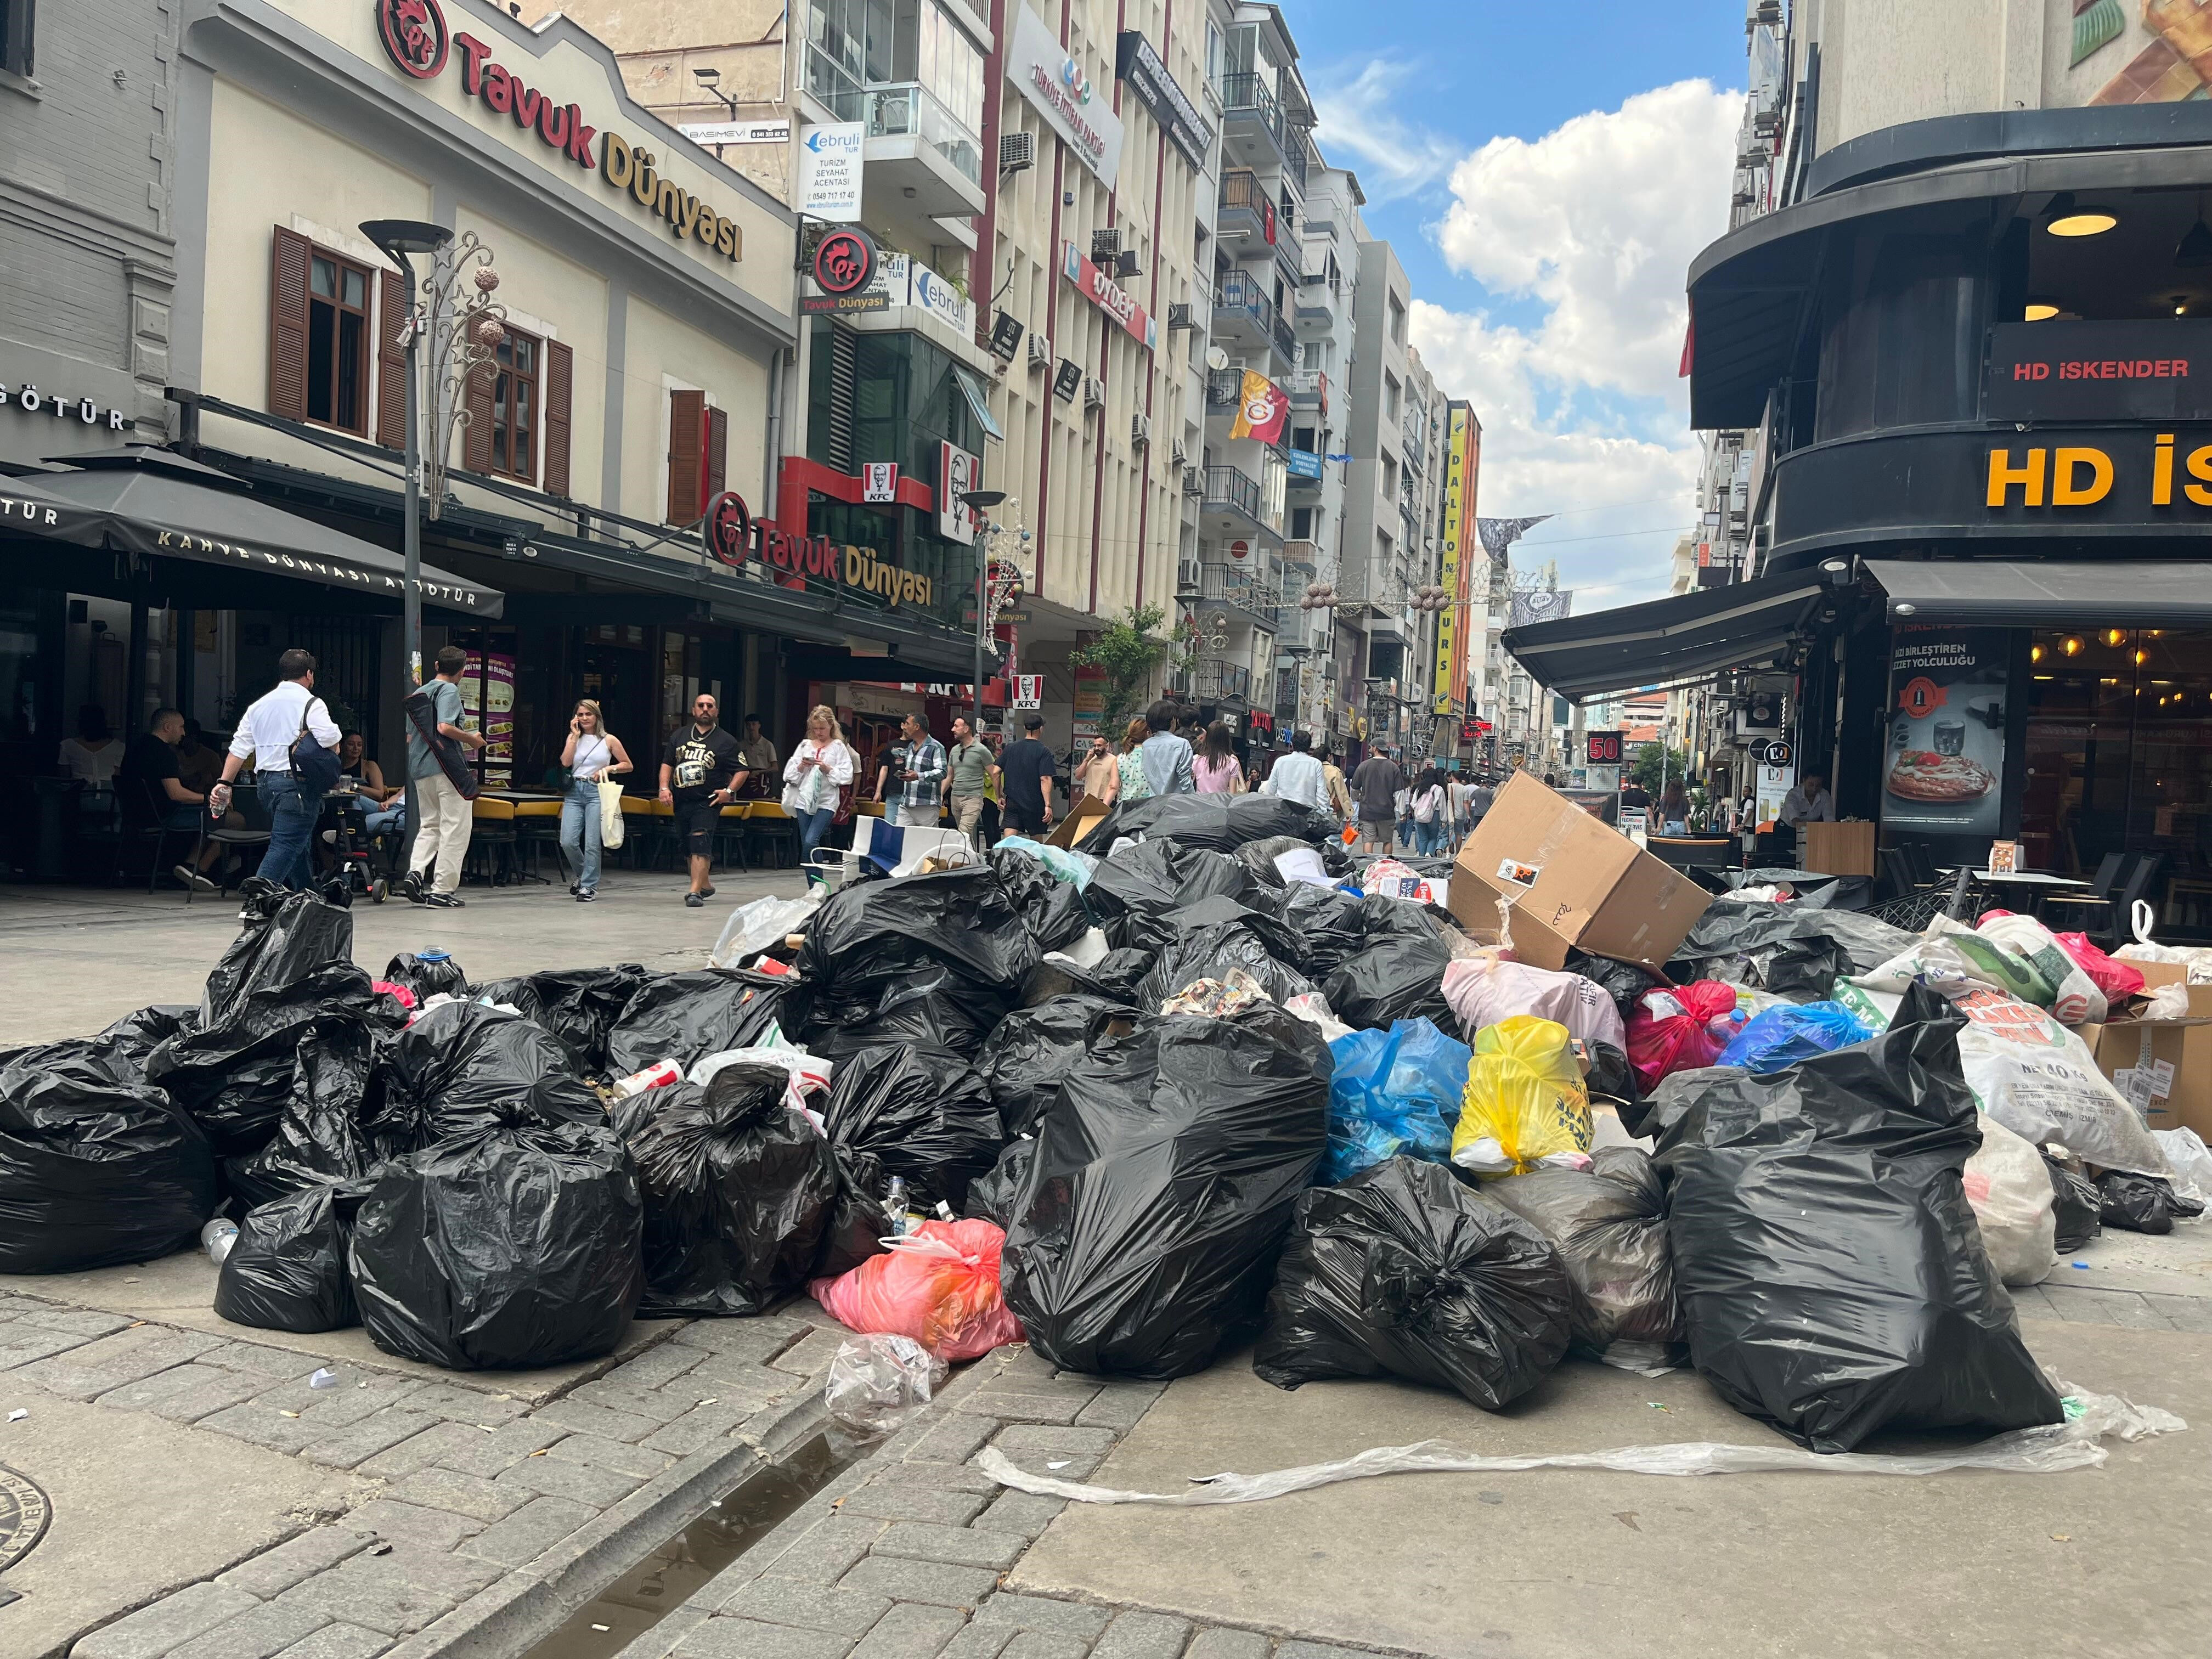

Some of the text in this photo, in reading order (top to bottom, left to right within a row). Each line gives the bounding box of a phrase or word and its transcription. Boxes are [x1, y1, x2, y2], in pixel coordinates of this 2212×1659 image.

[1034, 64, 1060, 106] TÜRKİYE
[690, 128, 745, 138] BASIMEVİ
[819, 133, 860, 146] ebruli
[453, 32, 742, 263] Tavuk Dünyası
[820, 158, 846, 167] TURİZM
[814, 178, 849, 187] ACENTASI
[878, 259, 904, 272] ruli
[804, 297, 883, 310] Tavuk Dünyası
[929, 286, 966, 323] ebruli
[955, 319, 965, 334] TUR
[2014, 363, 2049, 380] HD
[1987, 448, 2114, 506] HD
[1446, 455, 1460, 573] DALTON
[158, 532, 249, 558] KAHVE
[264, 553, 370, 583] DÜNYASI
[753, 517, 931, 607] Tavuk Dünyası
[1905, 642, 1966, 656] BİRLEŞTİREN
[1912, 654, 1976, 668] YOLCULUĞU
[1589, 737, 1618, 759] 50
[2021, 1063, 2088, 1082] NET 40 Kg
